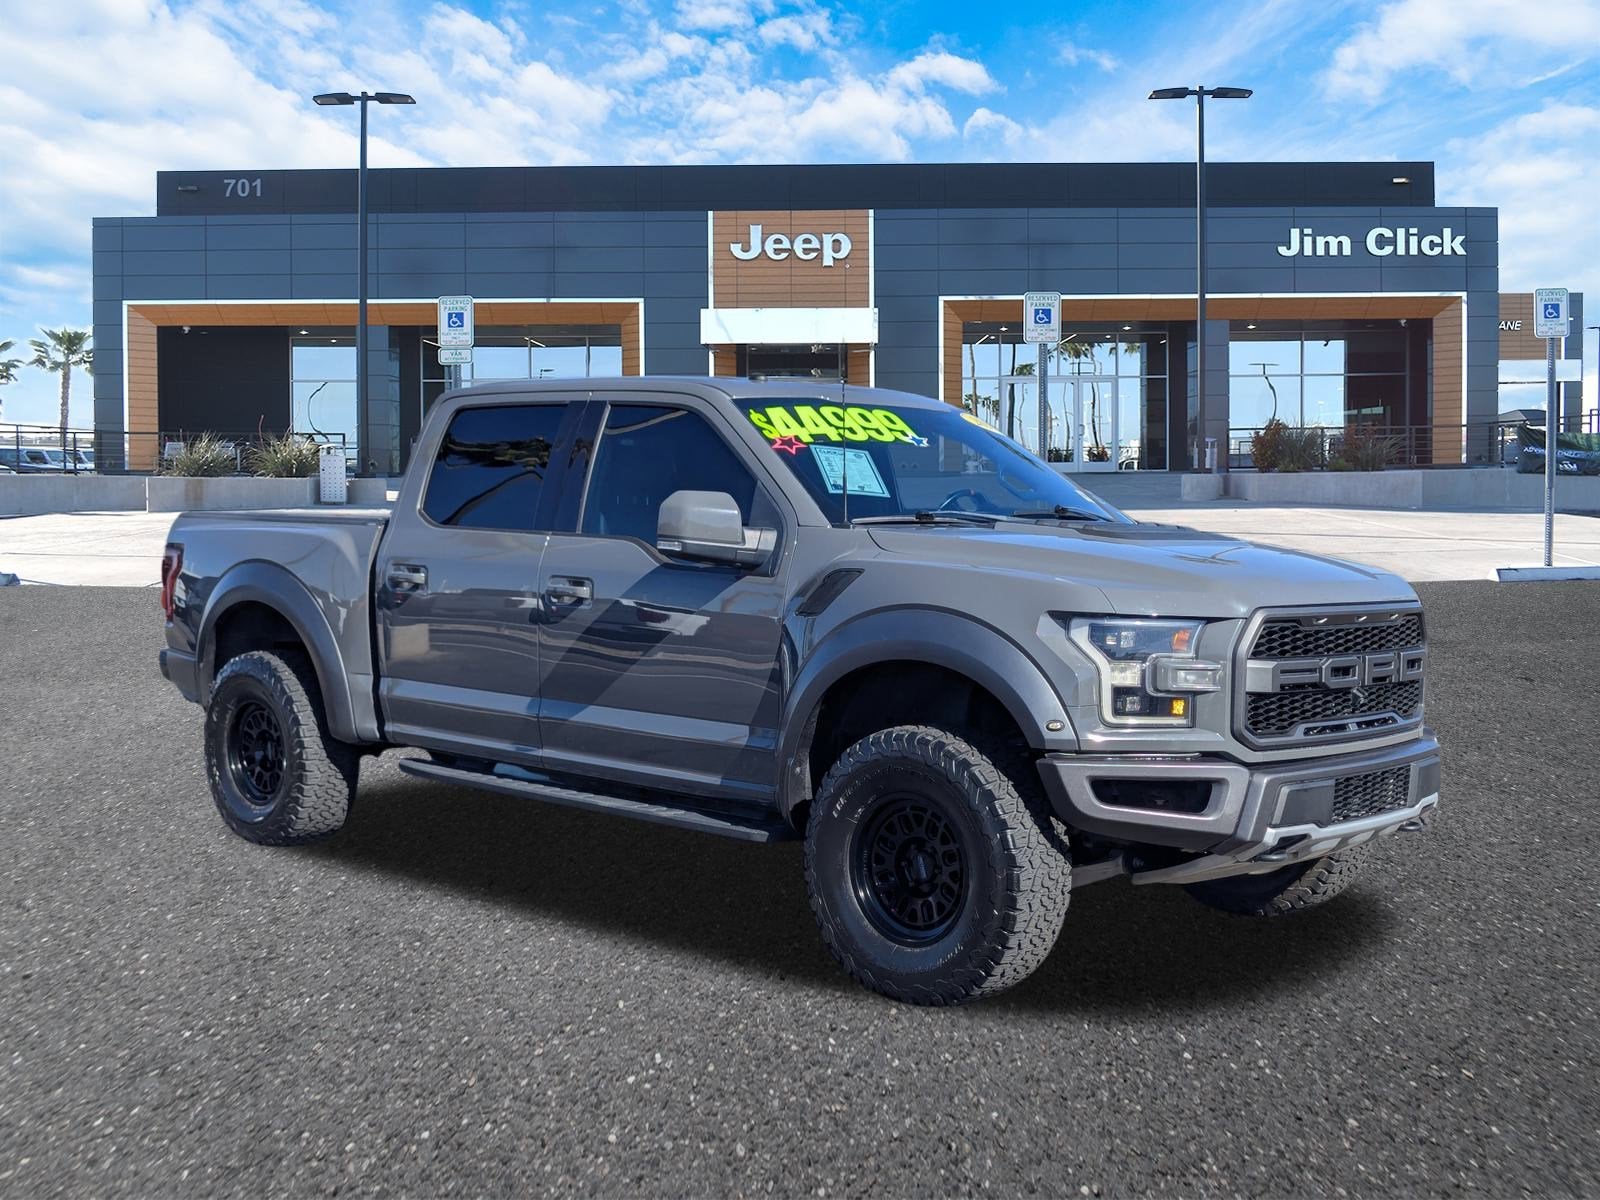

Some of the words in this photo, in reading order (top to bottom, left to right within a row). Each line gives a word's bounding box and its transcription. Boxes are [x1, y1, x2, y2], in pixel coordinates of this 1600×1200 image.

[223, 178, 262, 197] 701
[729, 224, 853, 267] Jeep
[1277, 227, 1352, 256] Jim
[1365, 227, 1467, 256] Click
[748, 404, 914, 445] $44999
[1277, 649, 1425, 690] FORD
